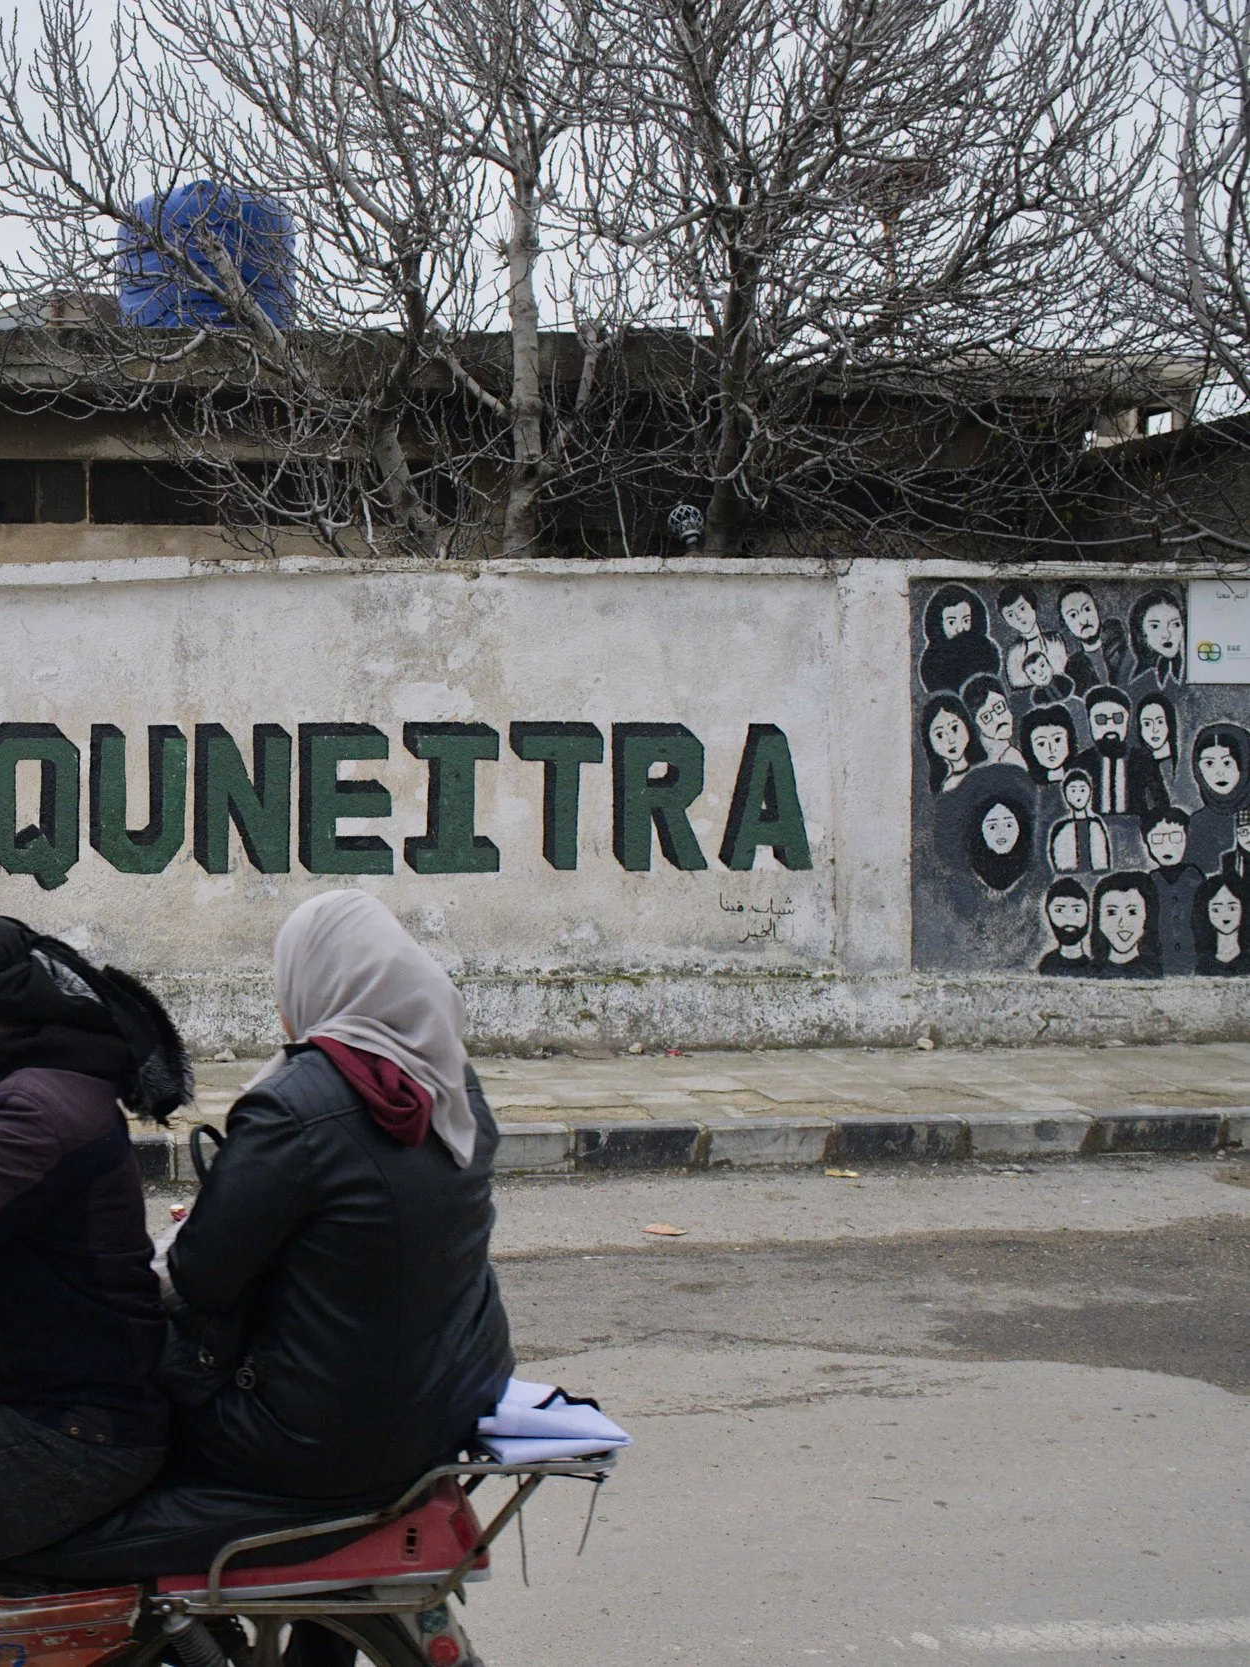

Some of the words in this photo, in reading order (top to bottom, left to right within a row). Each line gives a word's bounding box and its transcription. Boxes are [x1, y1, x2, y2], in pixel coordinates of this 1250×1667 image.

[720, 892, 744, 916] فينا
[751, 896, 795, 919] شباب
[737, 918, 776, 943] الخير
